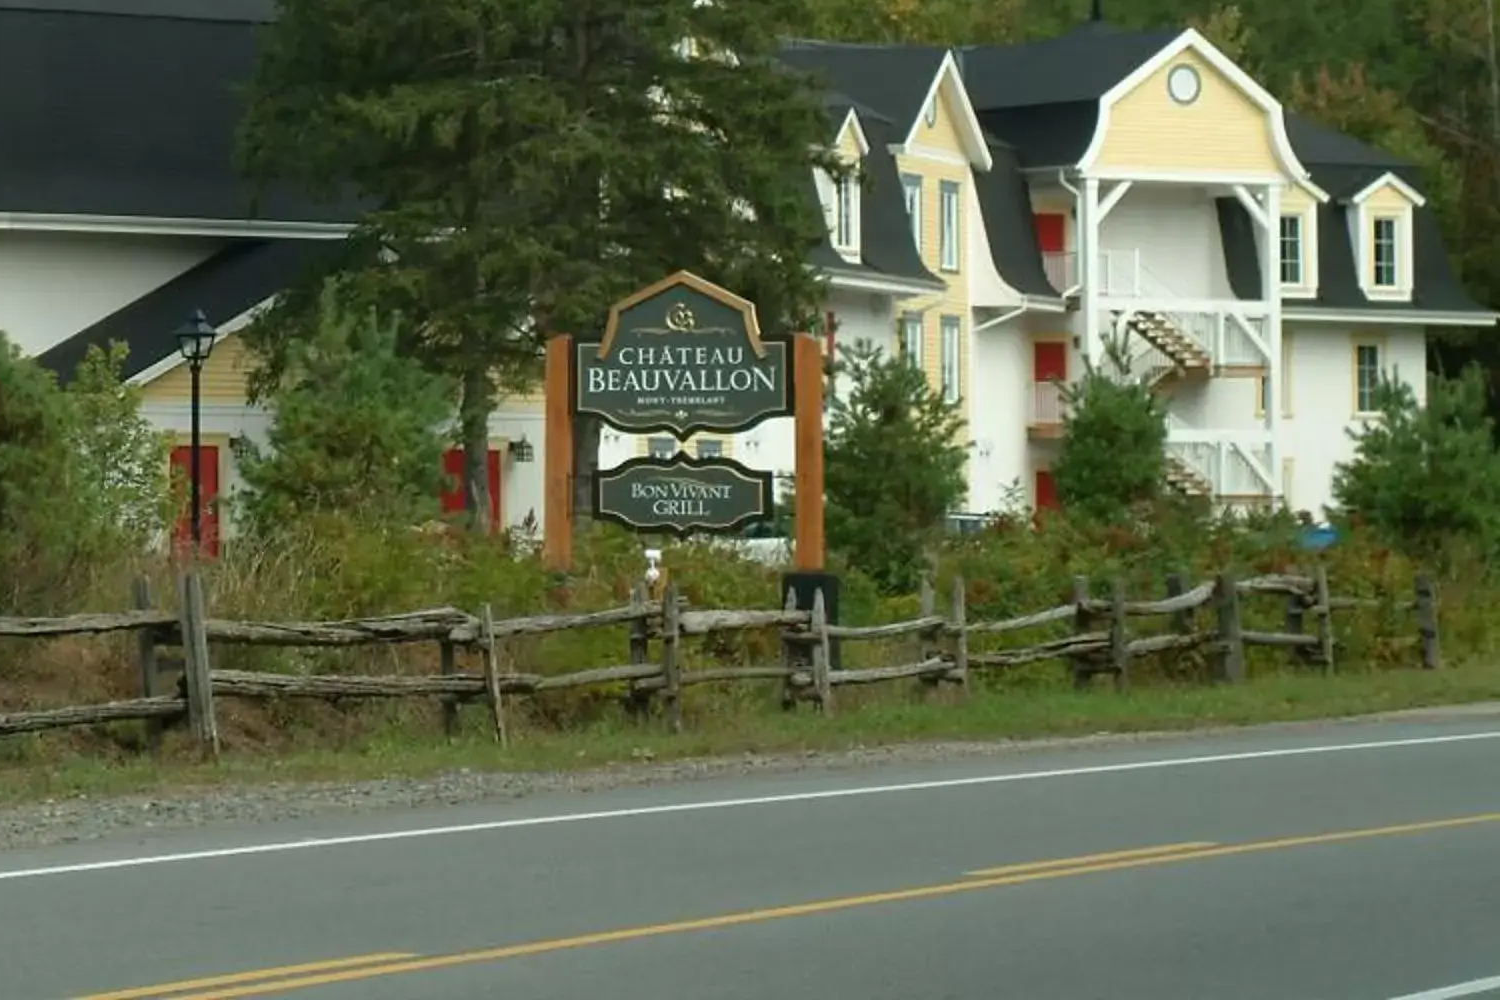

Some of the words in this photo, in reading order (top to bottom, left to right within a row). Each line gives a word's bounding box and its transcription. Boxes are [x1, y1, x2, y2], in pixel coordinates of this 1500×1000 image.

[619, 346, 743, 365] CHÂTEAU
[588, 366, 775, 393] BEAUVALLON
[631, 483, 668, 498] BON
[670, 483, 732, 499] VIVANT
[653, 500, 711, 515] GRILL
